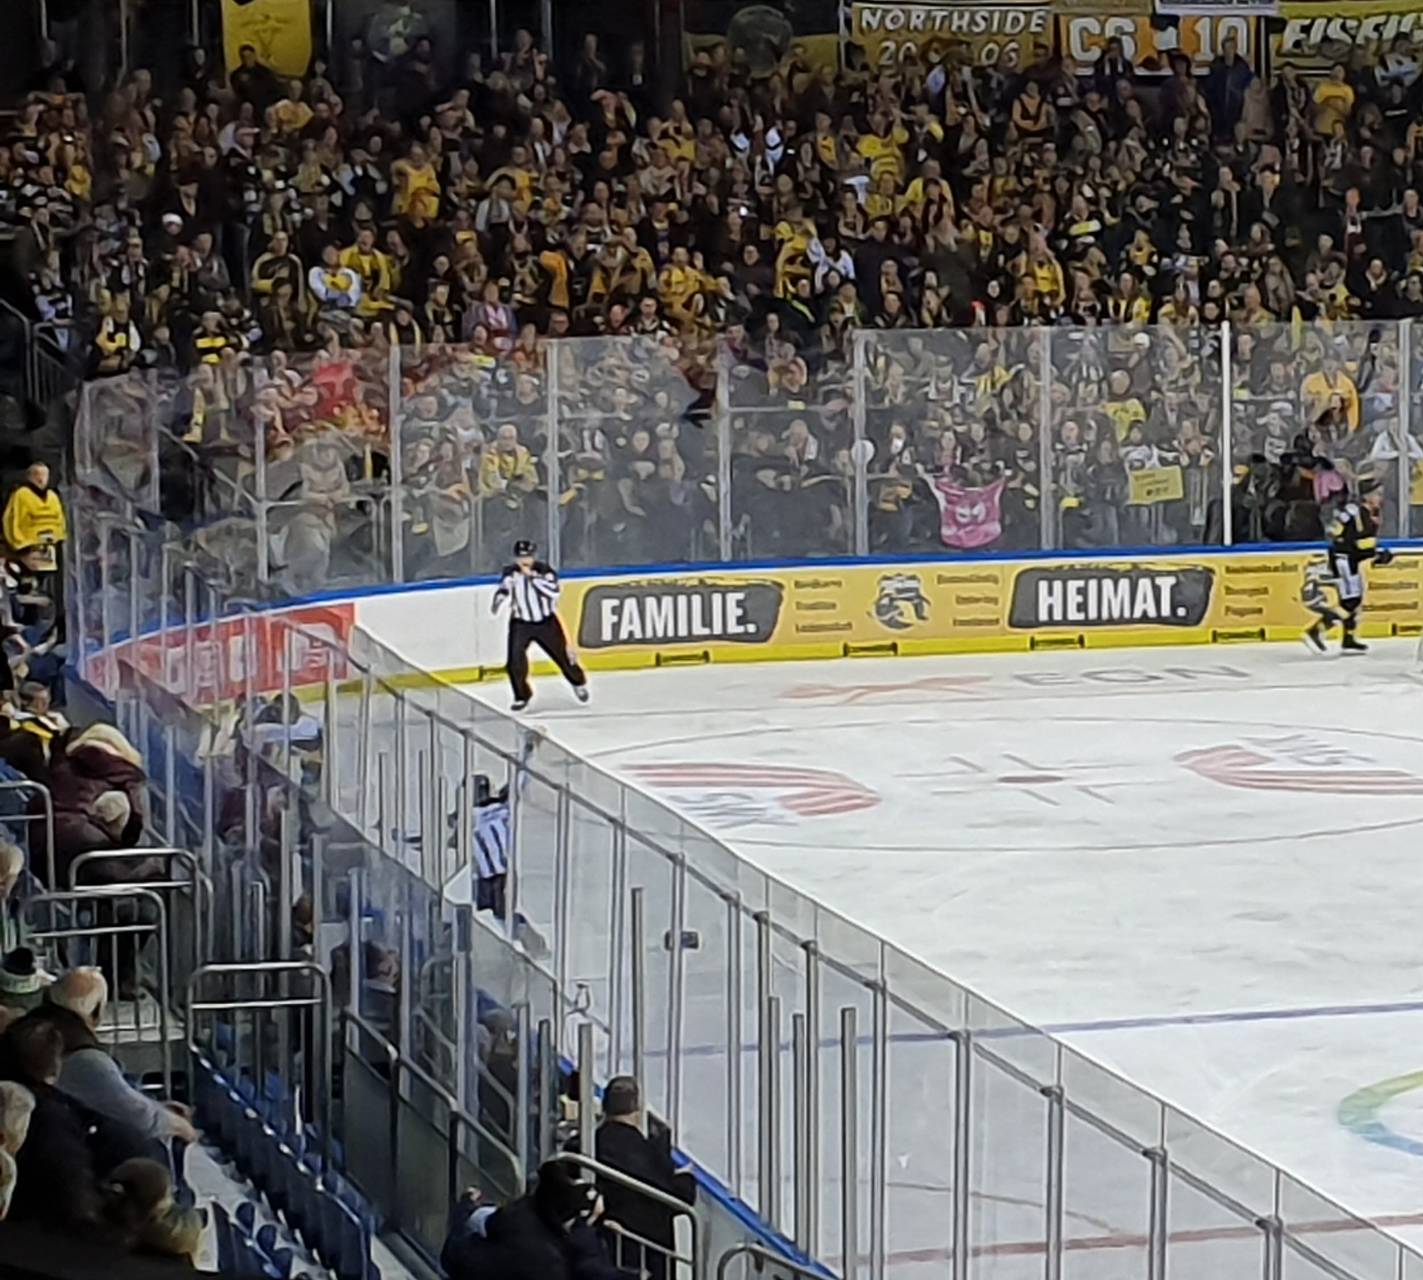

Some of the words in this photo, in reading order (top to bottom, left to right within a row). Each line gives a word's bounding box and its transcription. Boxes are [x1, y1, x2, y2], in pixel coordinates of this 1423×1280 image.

[861, 8, 1047, 35] NORTHSIDE
[600, 590, 758, 642] FAMILIE.
[1037, 574, 1188, 623] HEIMAT.
